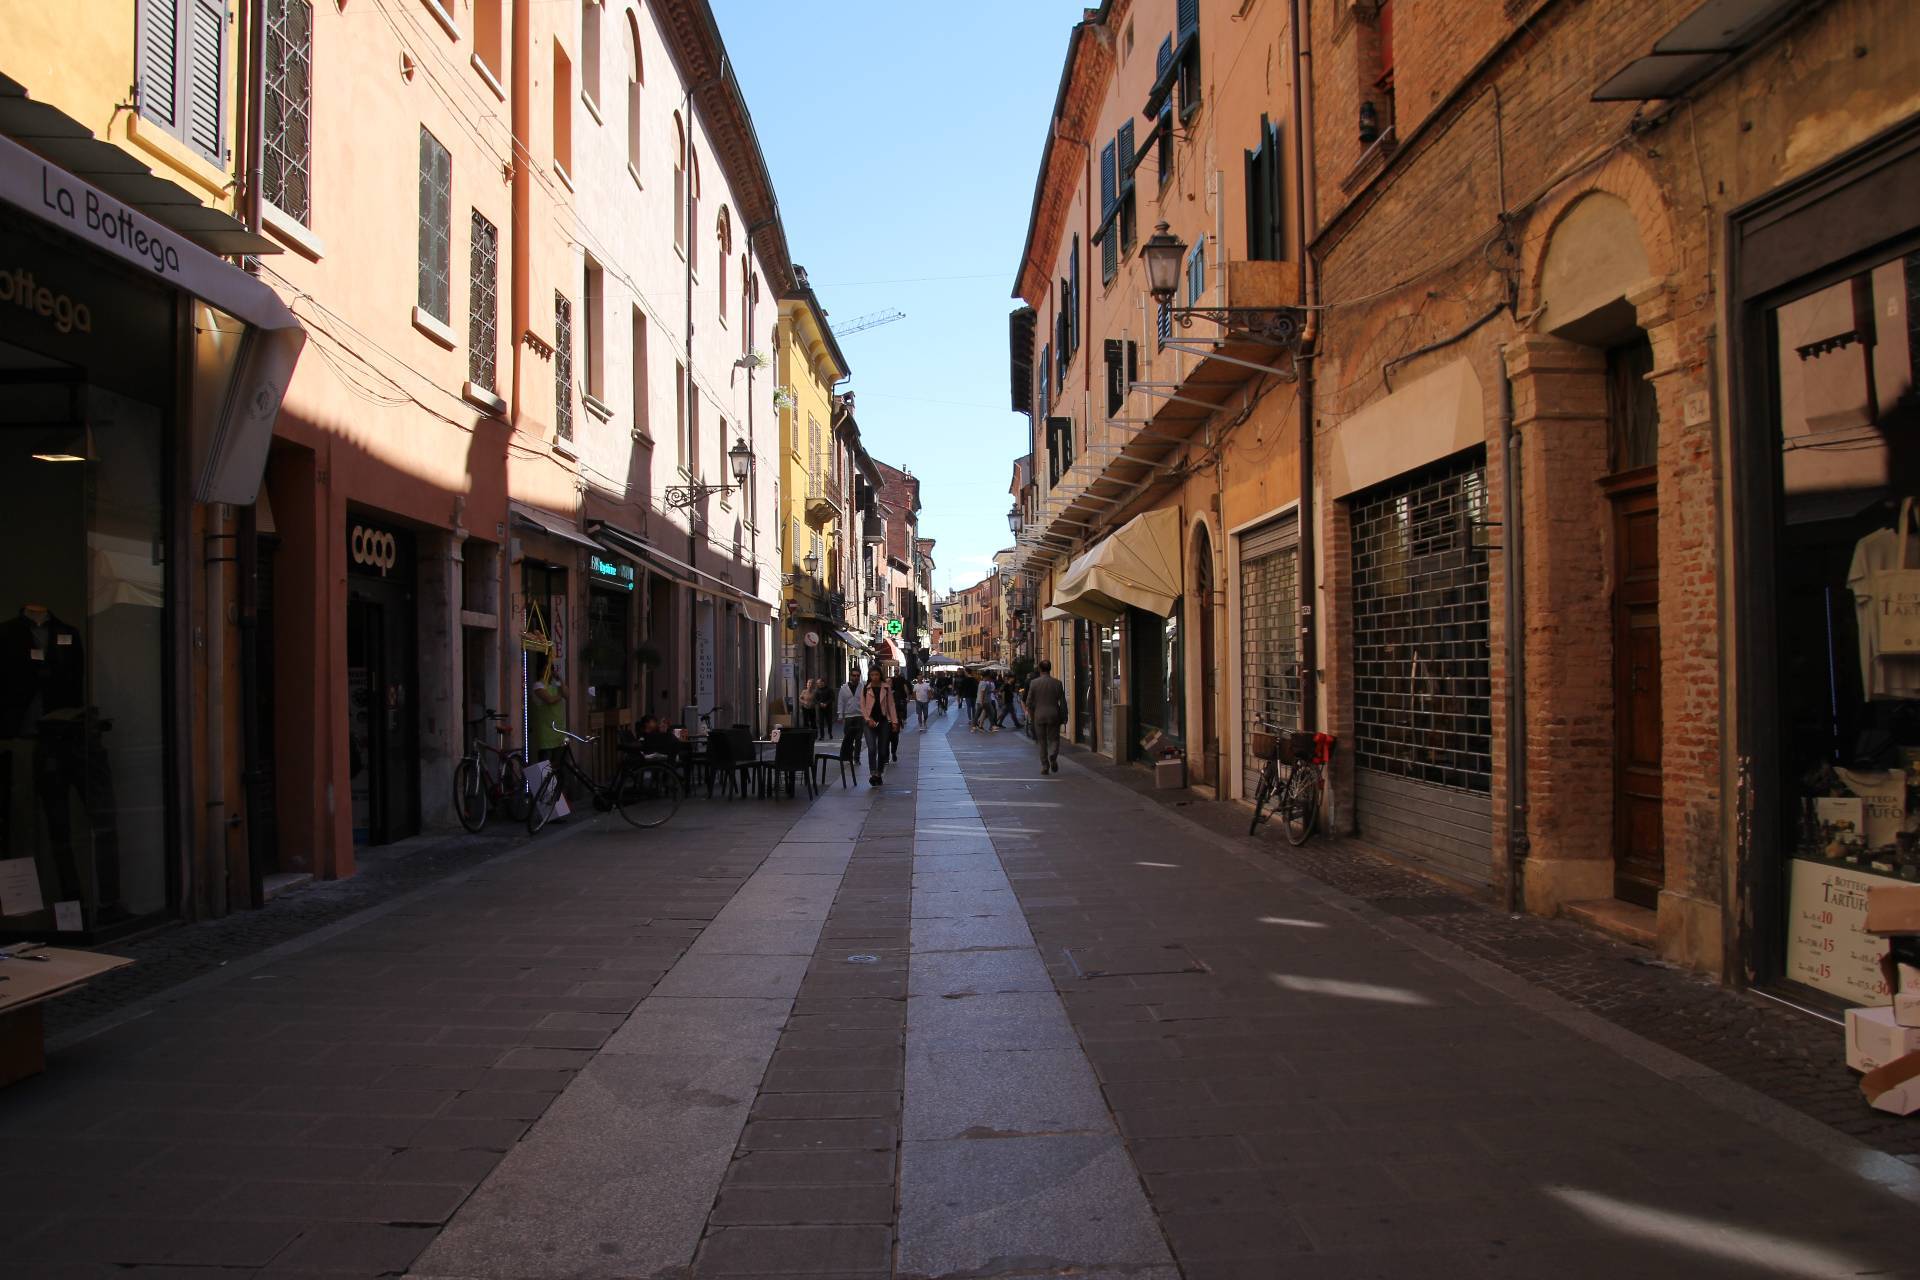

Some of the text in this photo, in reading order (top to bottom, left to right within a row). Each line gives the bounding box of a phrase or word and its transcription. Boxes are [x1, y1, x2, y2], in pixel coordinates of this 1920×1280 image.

[43, 165, 180, 273] La Bottega
[352, 525, 396, 577] coop
